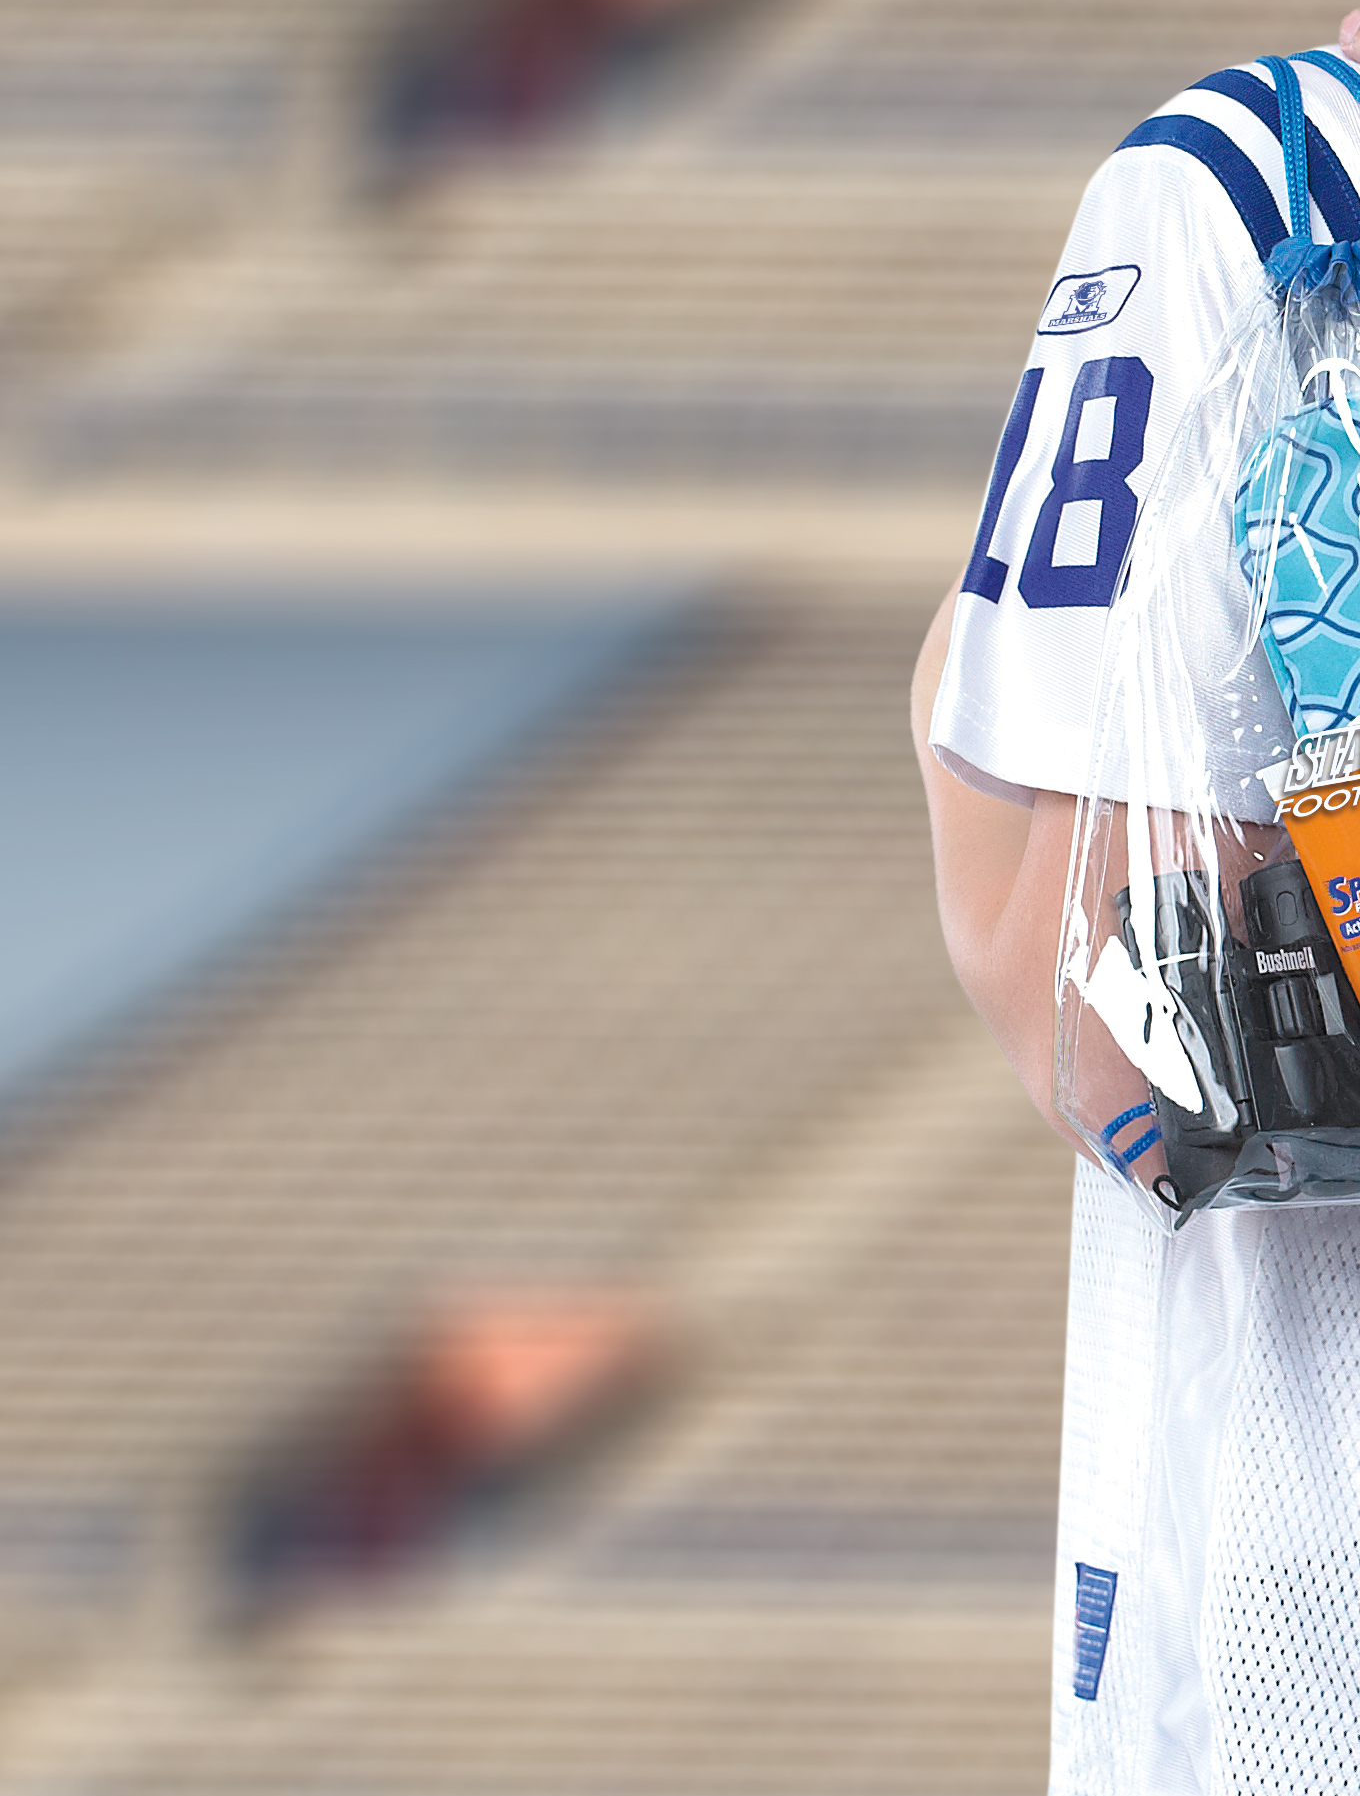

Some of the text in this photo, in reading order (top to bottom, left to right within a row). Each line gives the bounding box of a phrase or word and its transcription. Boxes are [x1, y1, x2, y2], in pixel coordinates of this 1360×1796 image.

[1048, 312, 1107, 327] MARSHALS
[960, 355, 1155, 609] 18
[1255, 946, 1316, 974] Bushnell
